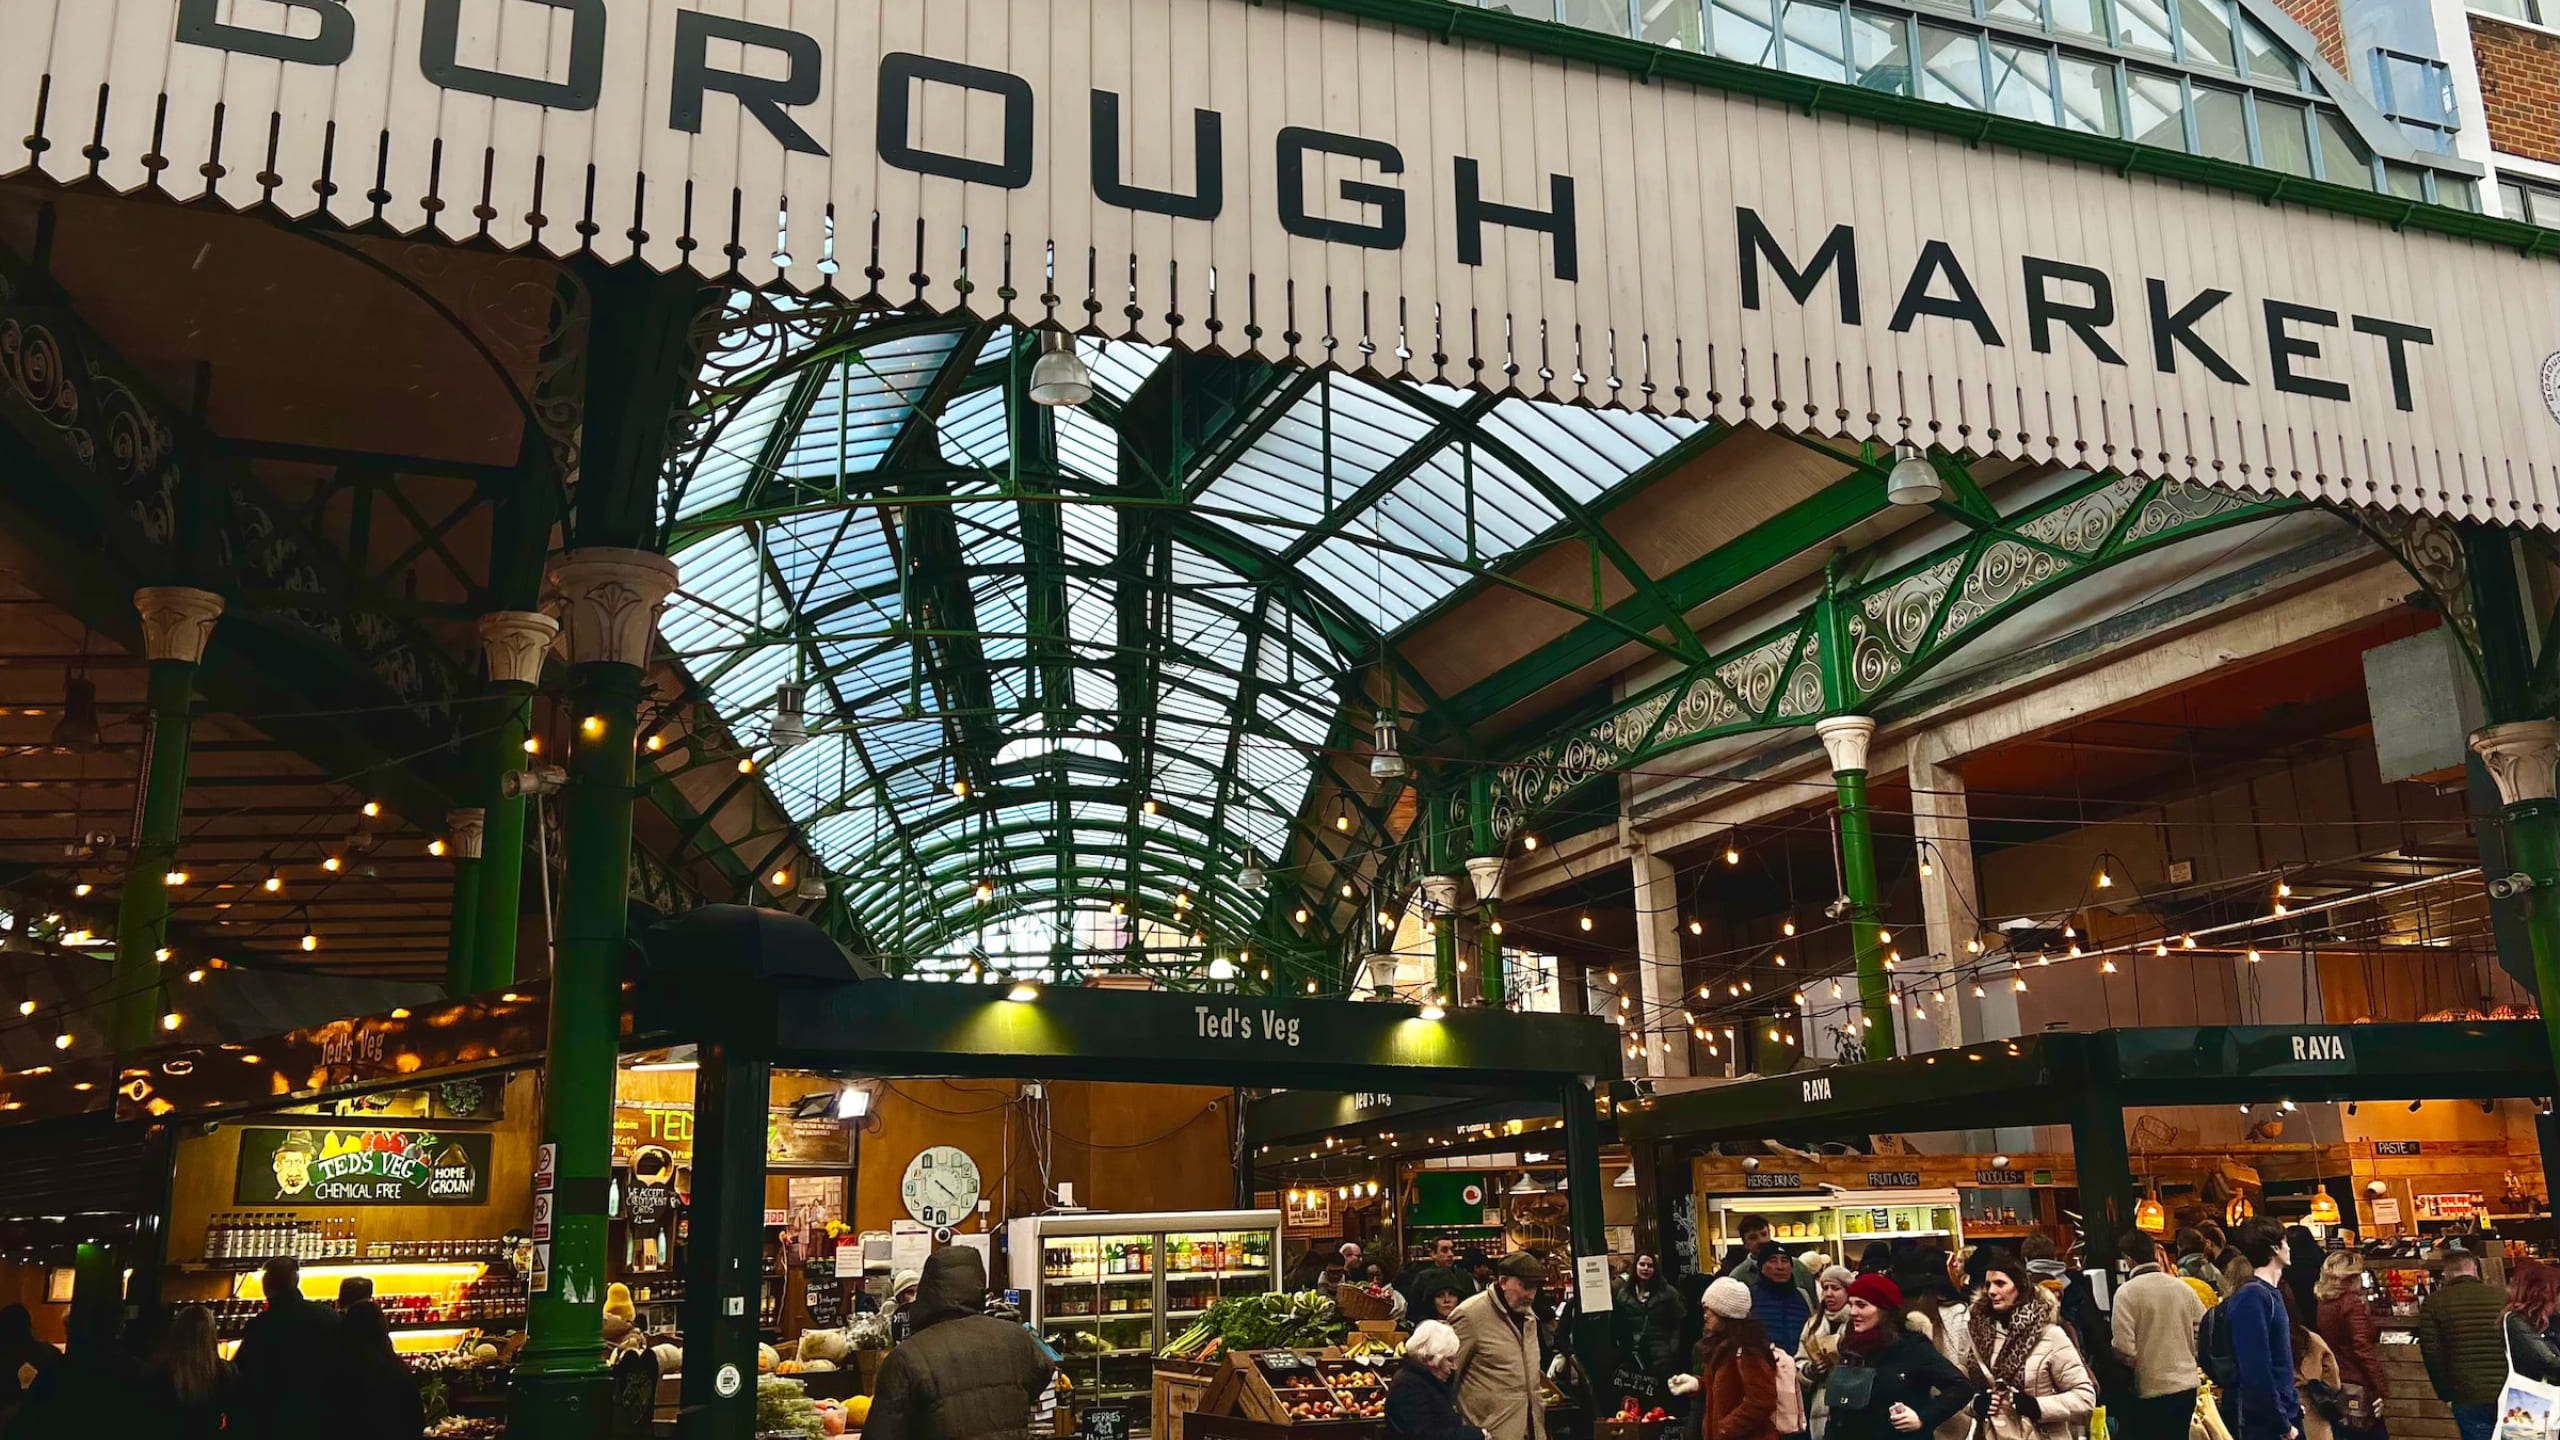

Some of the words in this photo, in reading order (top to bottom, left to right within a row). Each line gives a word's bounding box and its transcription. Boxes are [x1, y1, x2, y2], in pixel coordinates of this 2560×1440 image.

[1735, 205, 2434, 411] MARKET
[1195, 1005, 1252, 1039] Ted's
[1261, 1008, 1300, 1047] Veg
[321, 1032, 354, 1066] Ted's
[360, 1028, 385, 1062] Veg
[2291, 1035, 2346, 1061] RAYA
[1802, 1077, 1832, 1103] RAYA
[2378, 1141, 2409, 1155] PASTE
[318, 1151, 374, 1180] TED'S
[381, 1151, 416, 1179] VEG
[435, 1166, 466, 1180] HOME
[430, 1179, 470, 1194] GROWN
[1747, 1174, 1773, 1188] HERBS
[1774, 1174, 1800, 1187] DRINKS
[1868, 1173, 1893, 1186] FRUIT
[1899, 1172, 1918, 1186] VEG
[315, 1181, 372, 1200] CHEMICAL
[376, 1182, 402, 1200] FREE
[1091, 1410, 1121, 1424] BERRIES
